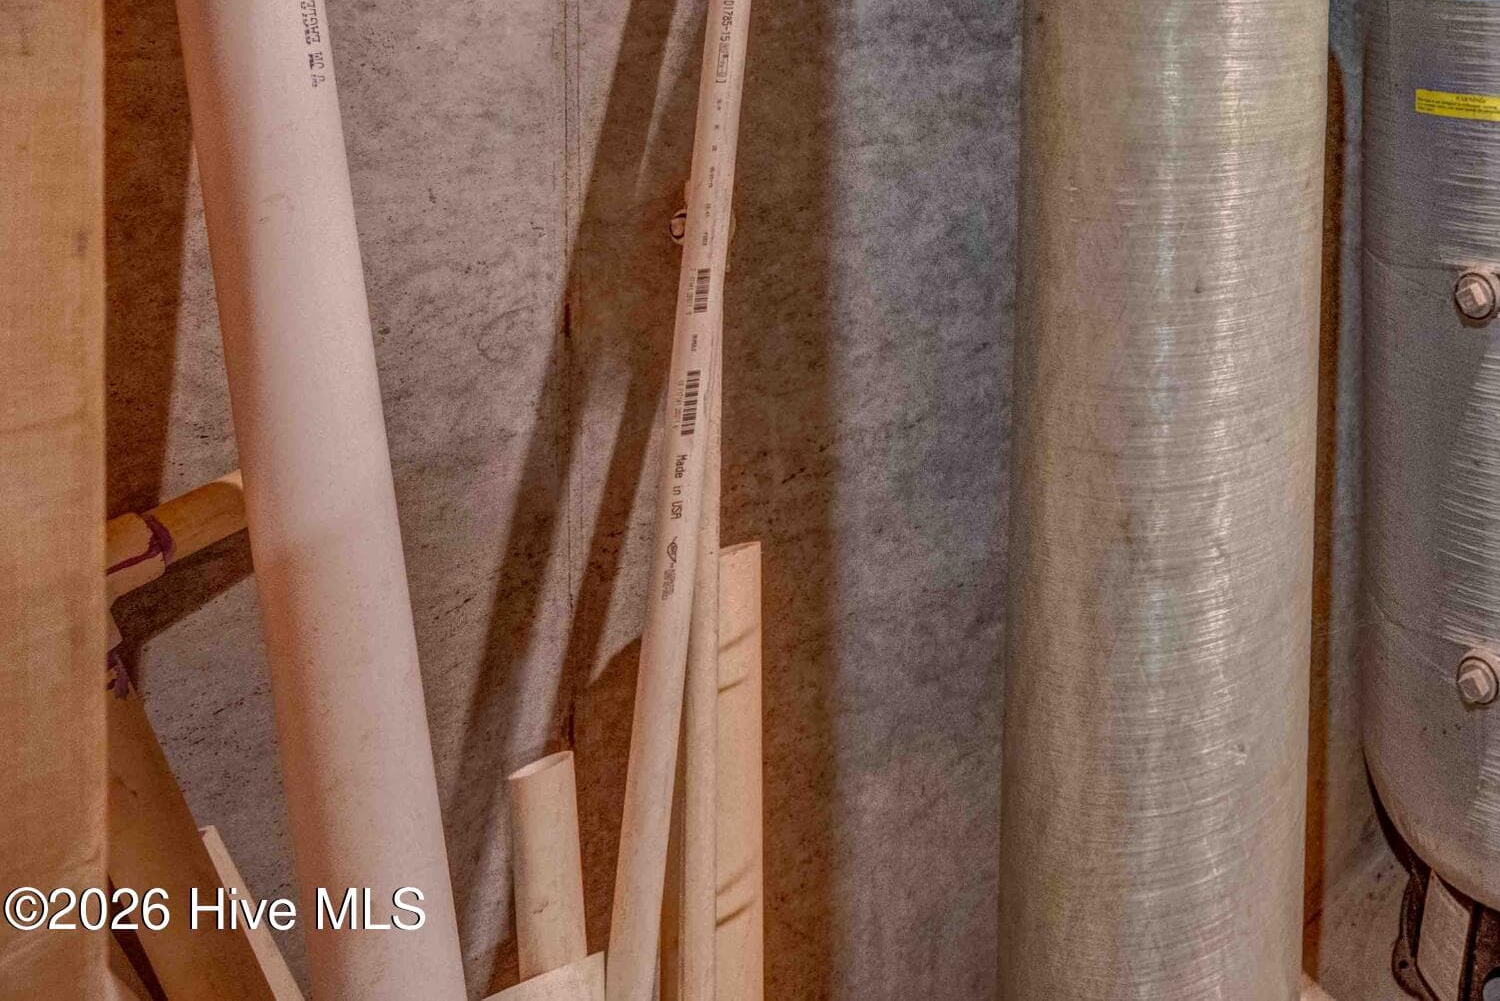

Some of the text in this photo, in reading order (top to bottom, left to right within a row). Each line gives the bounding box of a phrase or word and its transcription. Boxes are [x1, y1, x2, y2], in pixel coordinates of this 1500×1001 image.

[300, 0, 321, 44] EAGLE
[670, 453, 688, 520] Made in USA
